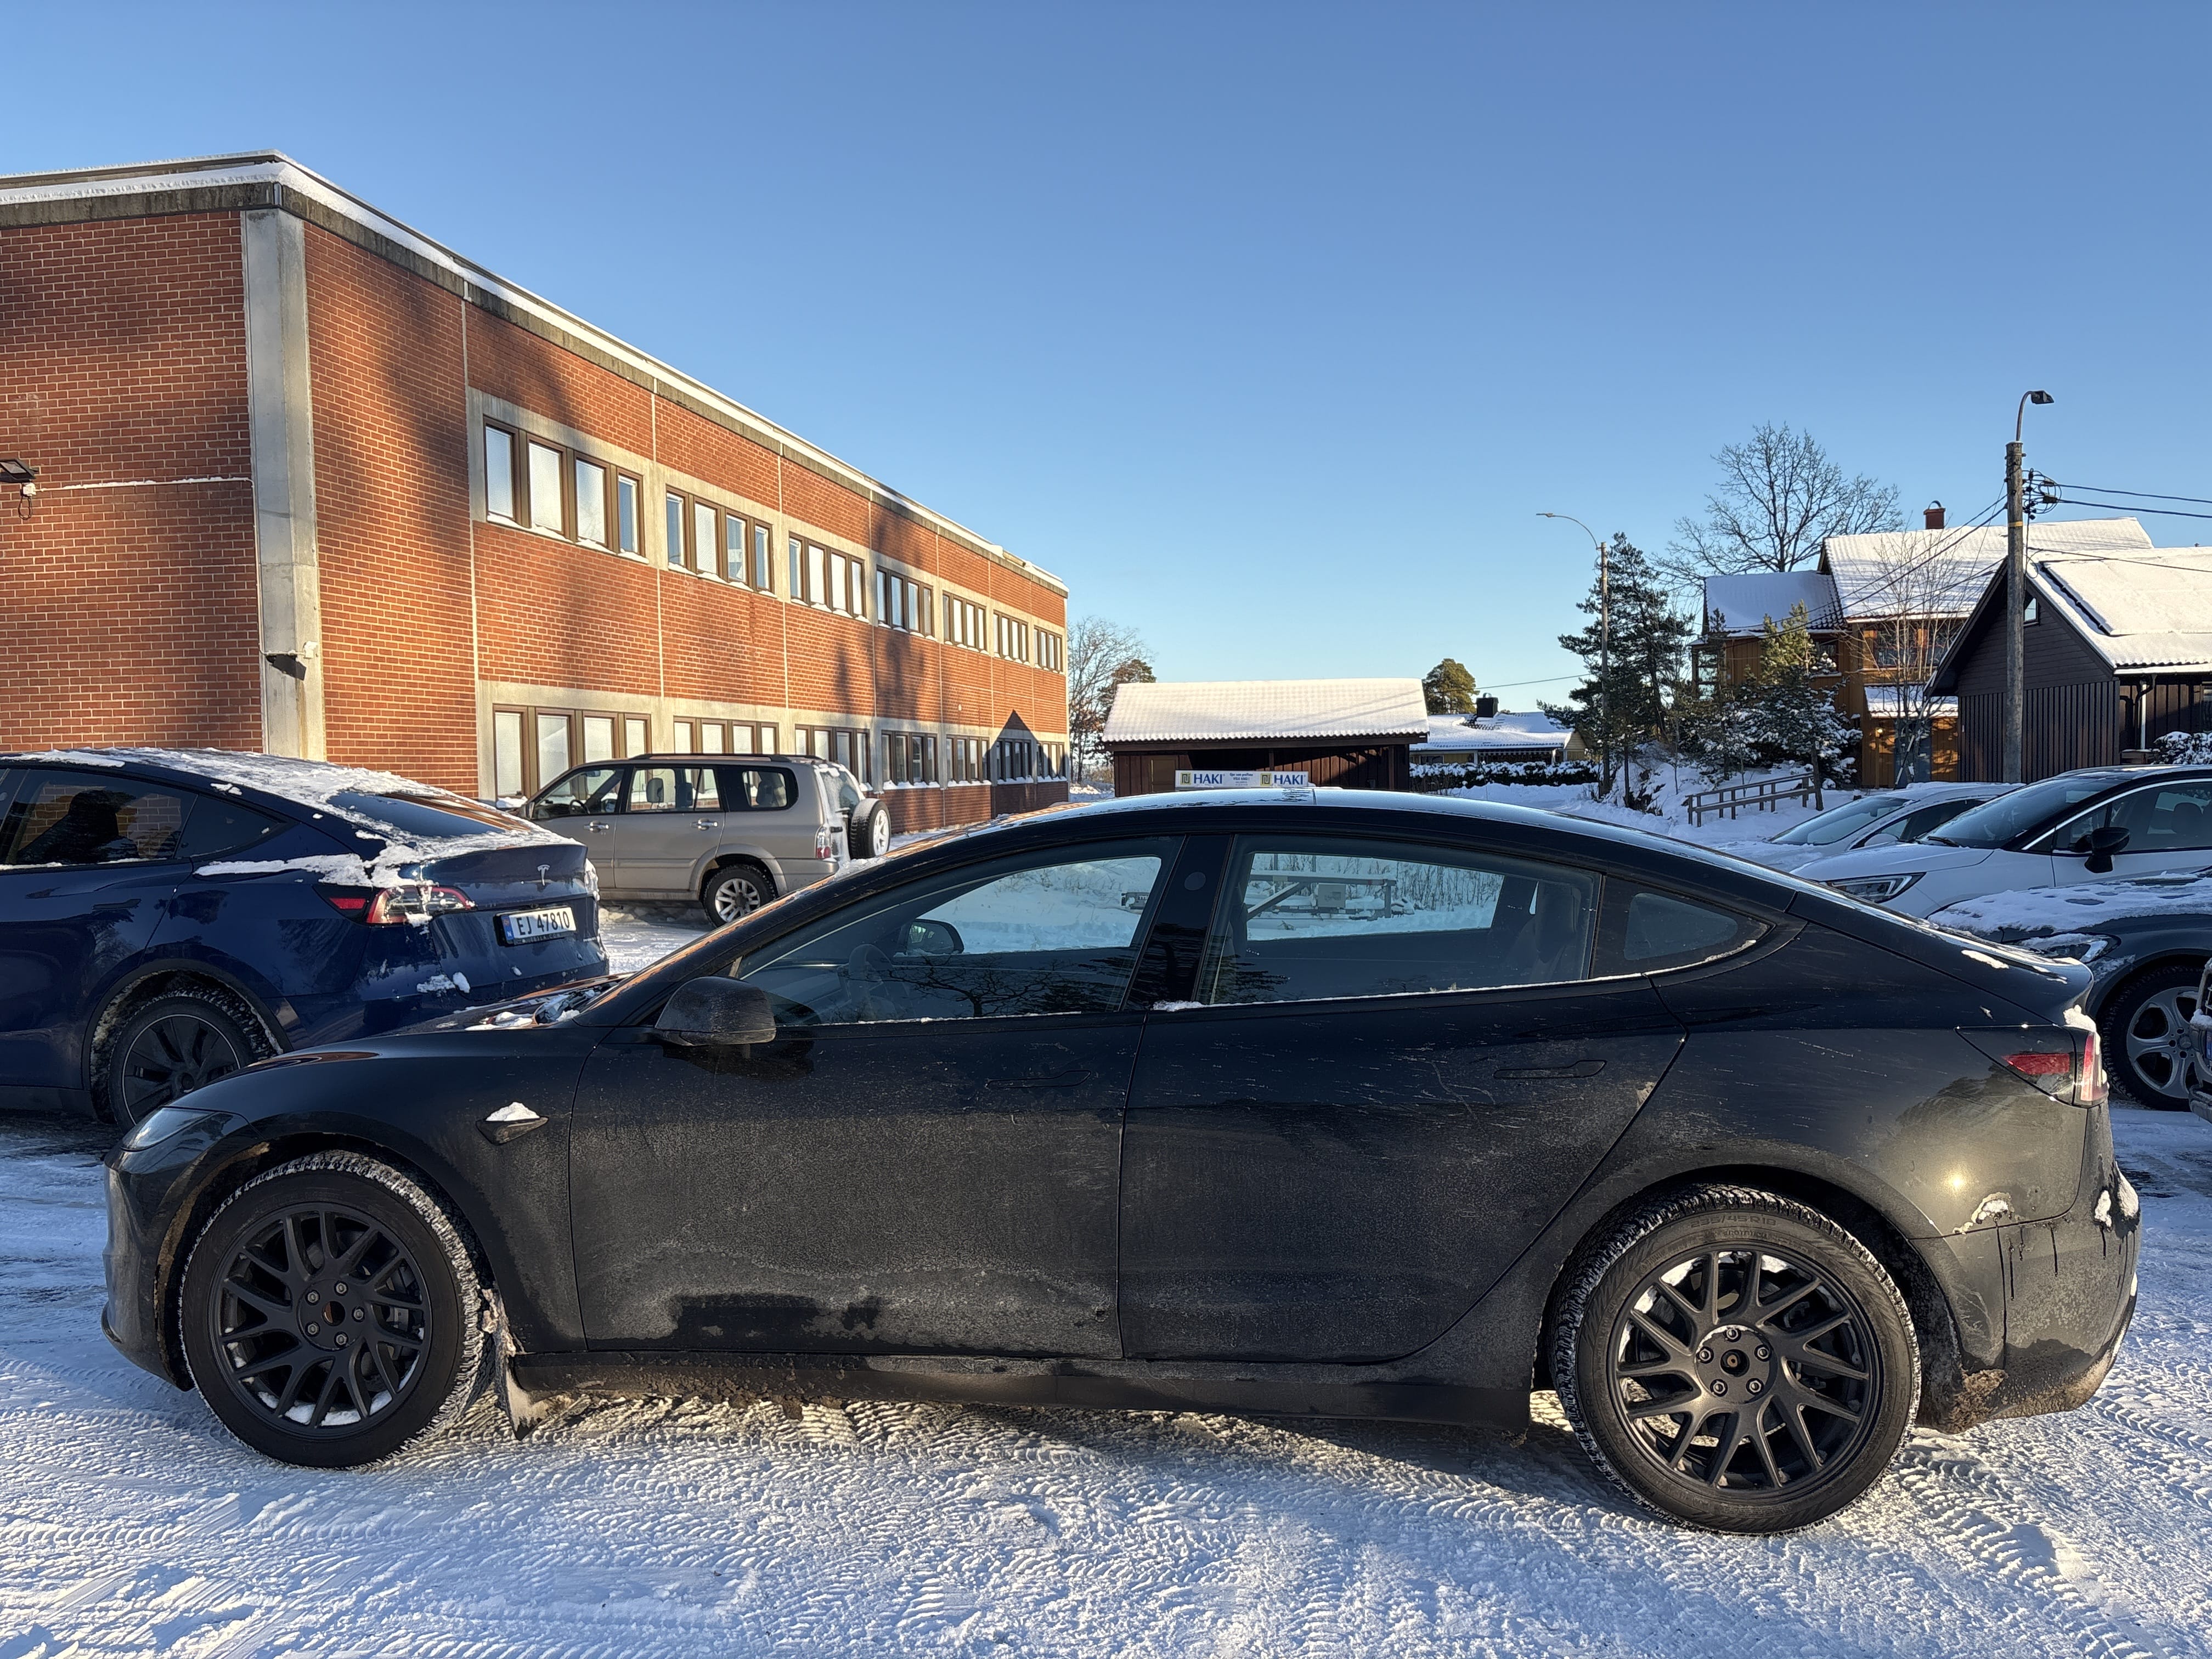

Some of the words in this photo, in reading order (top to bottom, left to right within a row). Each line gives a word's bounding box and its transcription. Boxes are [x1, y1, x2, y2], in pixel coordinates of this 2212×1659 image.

[1193, 774, 1222, 784] HAKI
[1274, 774, 1303, 785] HAKI
[516, 916, 532, 935] EJ
[537, 911, 570, 932] 47810
